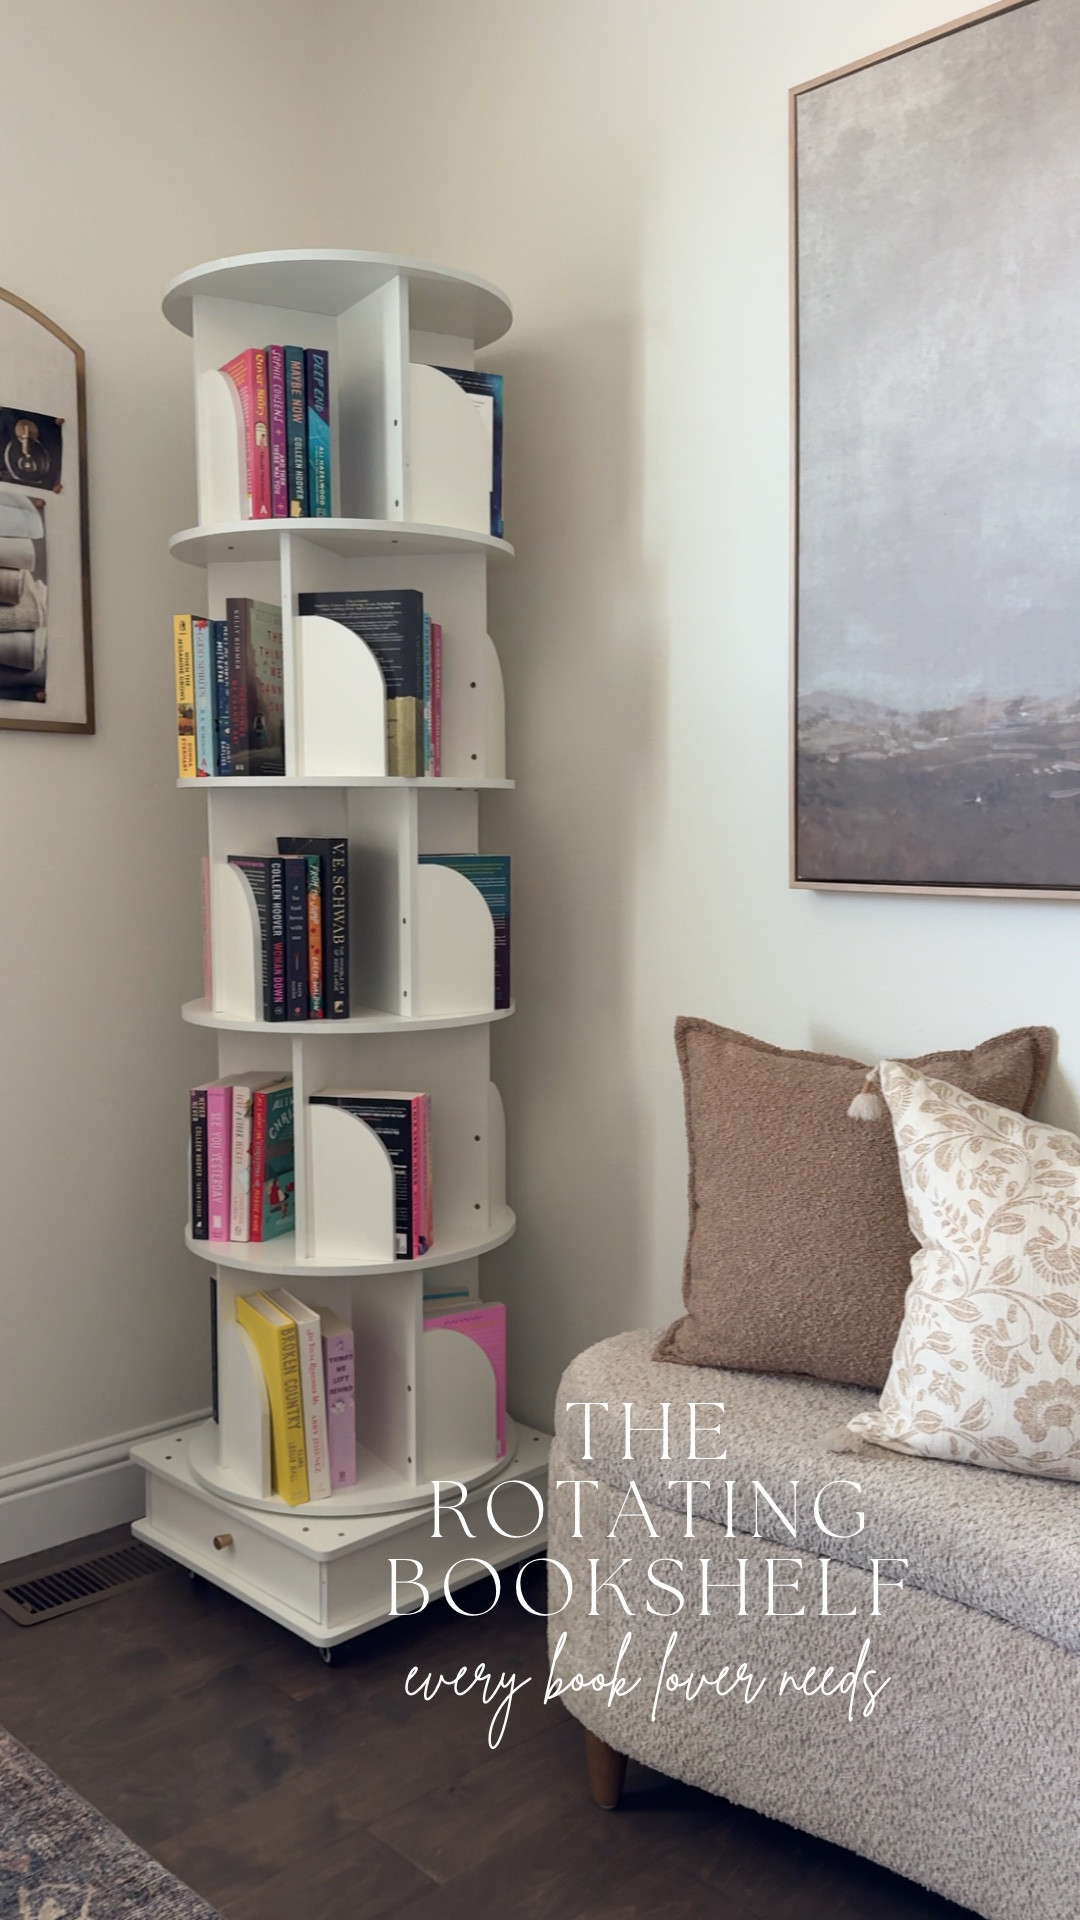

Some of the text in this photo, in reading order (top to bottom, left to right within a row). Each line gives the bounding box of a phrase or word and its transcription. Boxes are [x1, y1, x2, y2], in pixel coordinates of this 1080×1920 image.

[272, 350, 284, 424] SOPHIE COUSENS
[290, 360, 303, 424] MAYBE NOW
[312, 354, 324, 412] DEEP END
[294, 437, 304, 500] COLLEEN HOOVER
[233, 609, 241, 634] KELLY
[216, 641, 224, 683] MISTLETOE
[272, 863, 282, 937] COLLEEN HOOVER
[309, 864, 319, 888] FROM
[332, 843, 345, 944] V. E. SCHWAB
[310, 901, 320, 925] JUMP
[273, 943, 284, 1004] WOMAN DOWN
[311, 956, 321, 1012] LACIE WALDON
[195, 1126, 203, 1152] COLLEEN
[195, 1154, 203, 1177] HOOVER
[210, 1112, 223, 1204] SEE YOU YESTERDAY
[281, 1327, 302, 1431] BROKEN COUNTRY
[329, 1385, 353, 1395] BEHIND
[333, 1375, 350, 1385] LEFT
[312, 1438, 322, 1473] JIMENEZ
